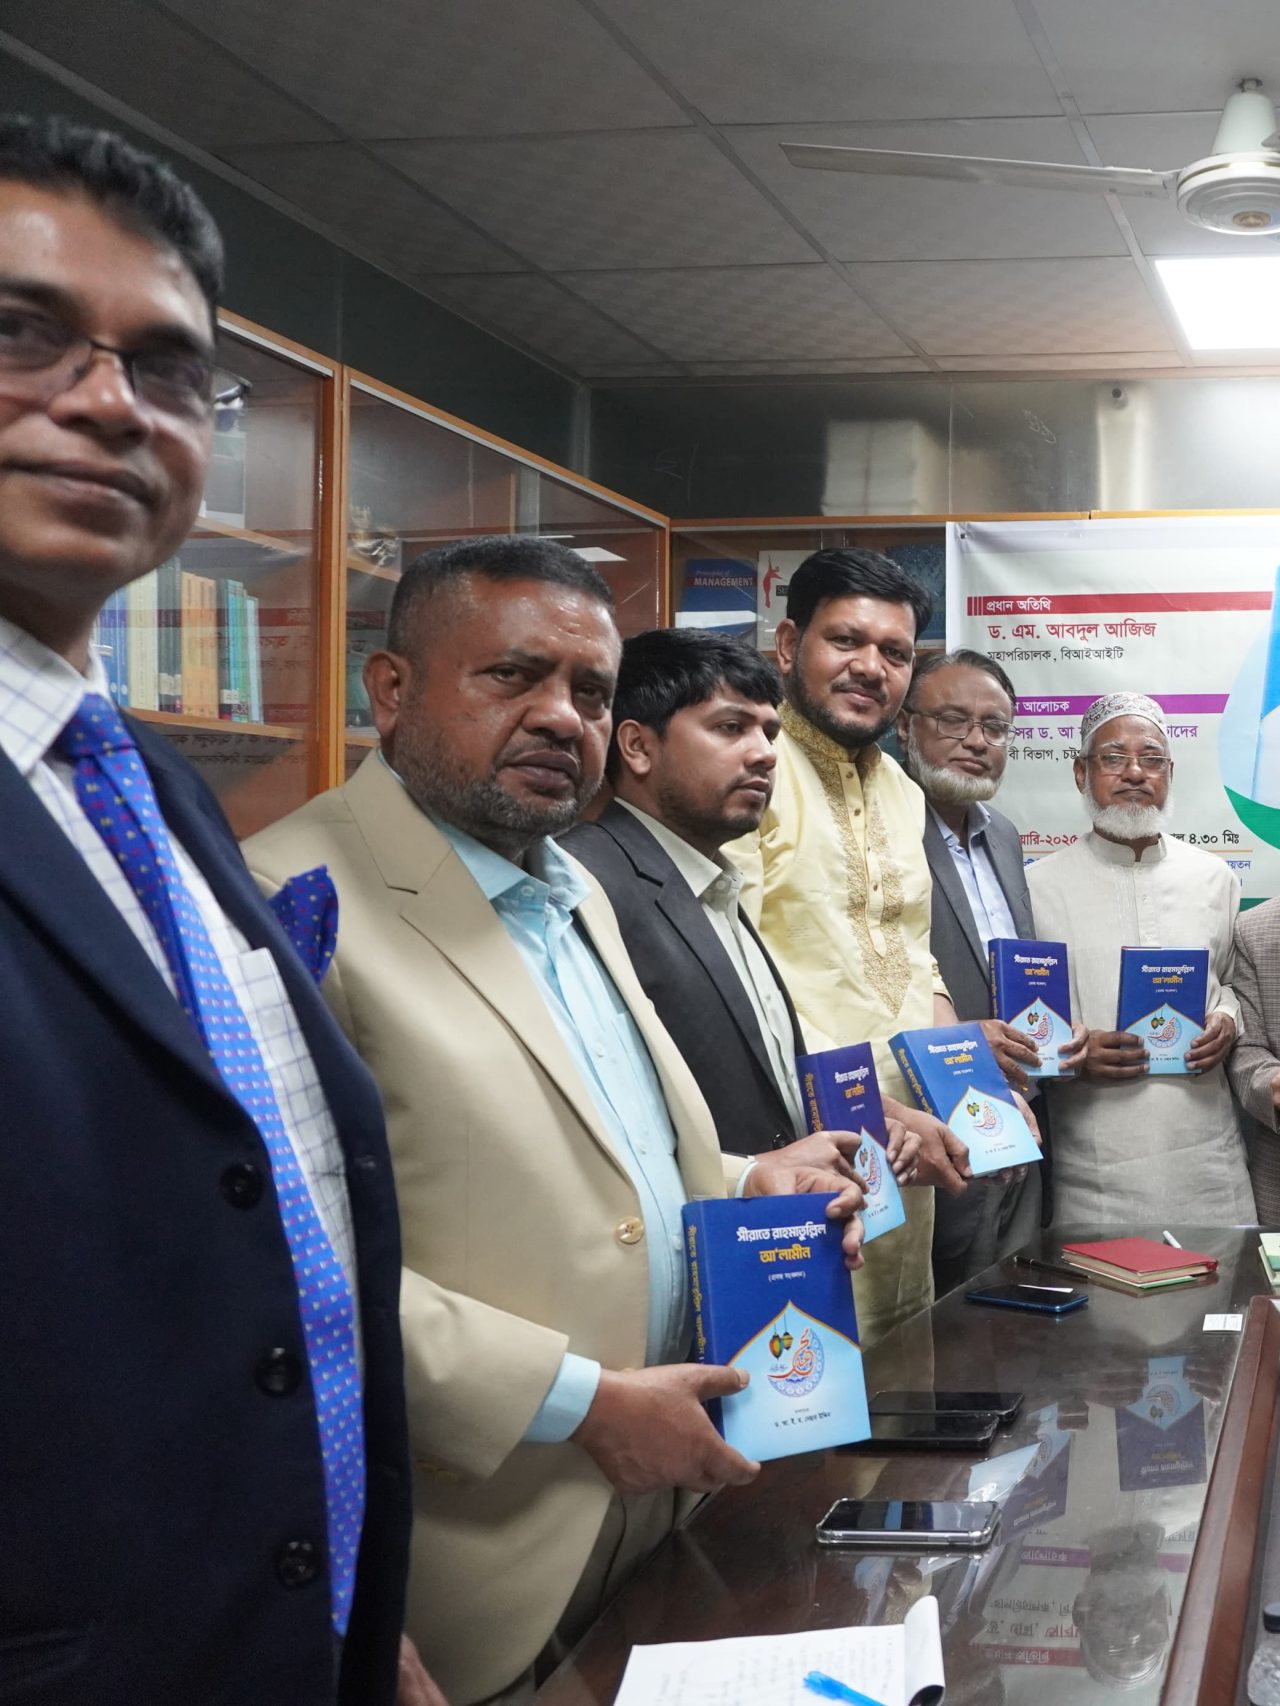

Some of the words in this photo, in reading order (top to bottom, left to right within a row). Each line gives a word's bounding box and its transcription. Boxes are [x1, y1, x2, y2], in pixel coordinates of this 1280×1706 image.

[694, 577, 753, 587] MANAGEMENT
[986, 600, 1013, 612] প্রধান
[1016, 597, 1052, 612] অতিথি
[987, 625, 1006, 640] ড.
[1012, 624, 1040, 639] এম.
[1046, 623, 1100, 641] আবদুল
[1104, 618, 1157, 639] আজিজ
[1061, 646, 1124, 660] বিআইআইটি
[1022, 701, 1070, 713] আলোচক
[1037, 727, 1053, 740] ড.
[1057, 726, 1075, 739] আ
[1189, 833, 1218, 845] ৪.৩০
[1222, 829, 1240, 845] মিঃ
[736, 1226, 770, 1242] সীরাতে
[771, 1221, 826, 1241] রাহমাতুল্লিল
[759, 1243, 811, 1262] আ'লামীন
